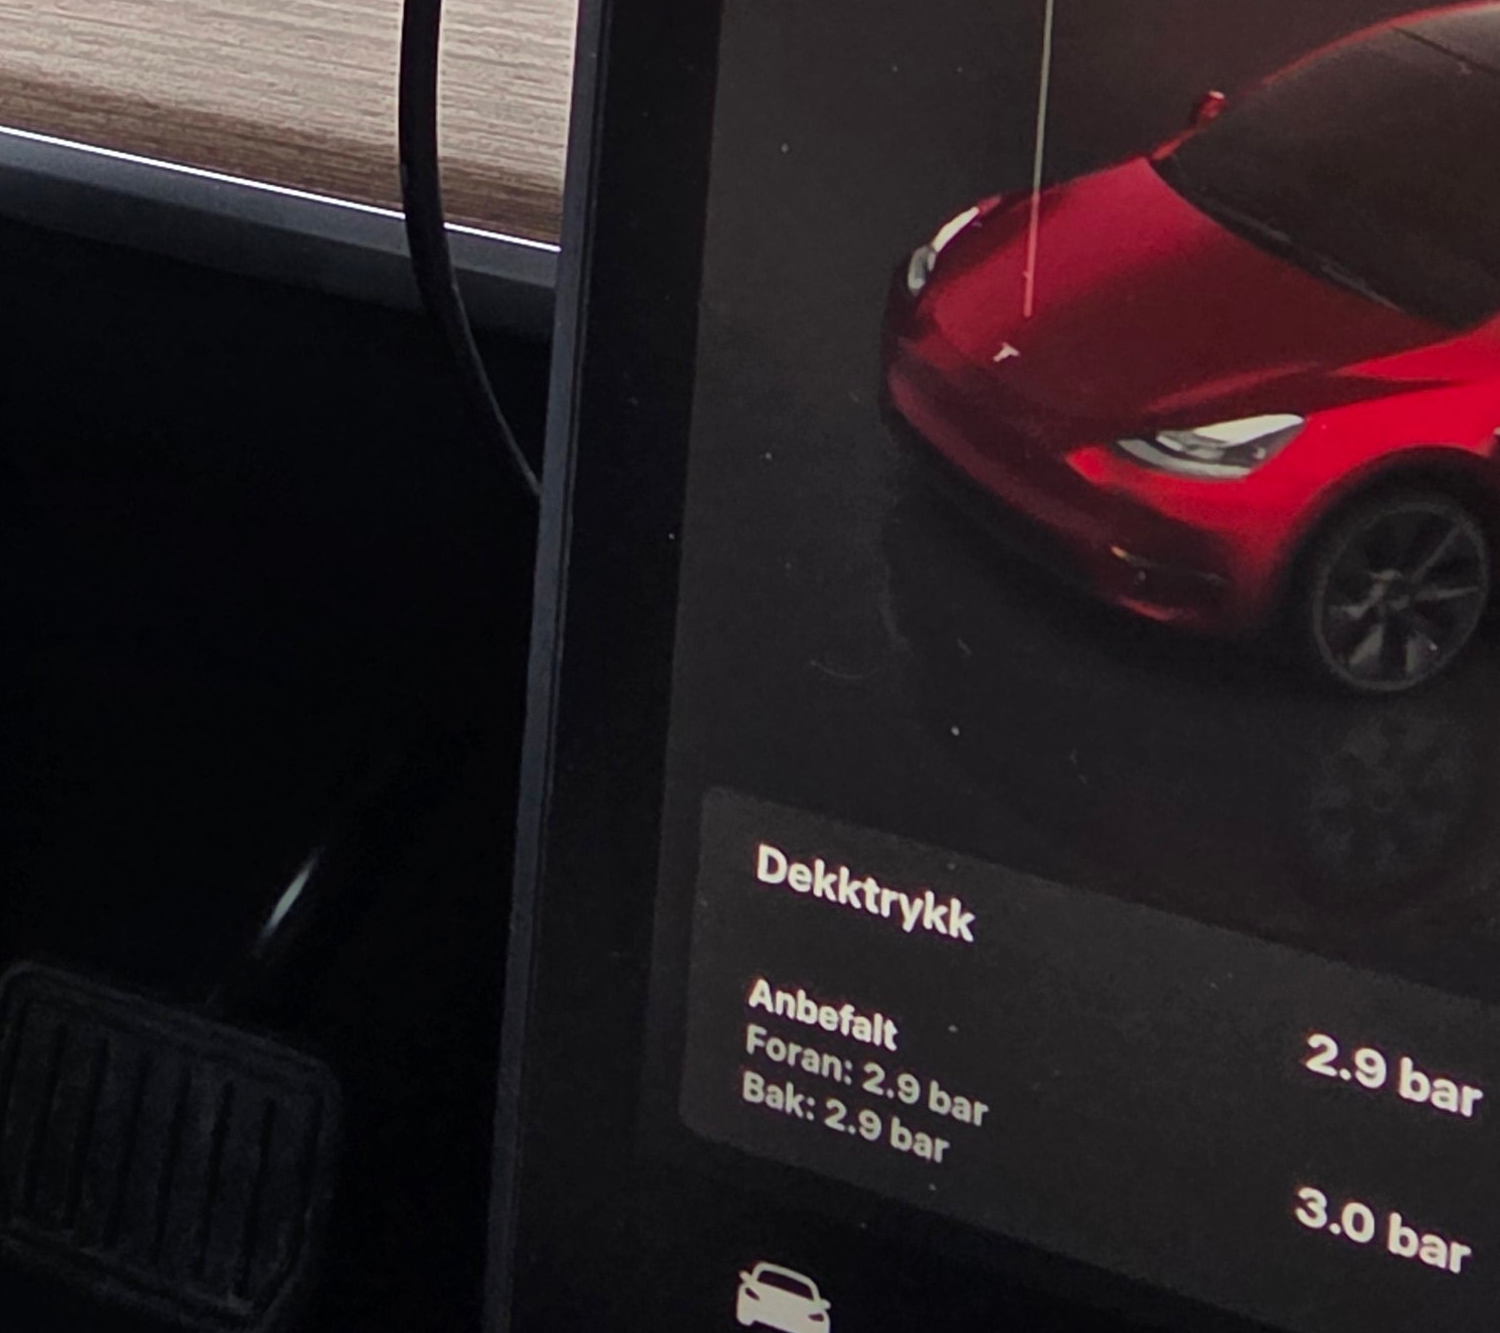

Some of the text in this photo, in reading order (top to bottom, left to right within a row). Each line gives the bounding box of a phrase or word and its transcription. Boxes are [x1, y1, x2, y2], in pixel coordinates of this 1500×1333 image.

[756, 844, 976, 943] Dekktrykk
[748, 979, 898, 1052] Anbefalt
[742, 1071, 950, 1163] Bak: 2.9 bar
[746, 1024, 990, 1126] Foran: 2.9 bar
[1305, 1034, 1484, 1118] 2.9 bar
[1295, 1187, 1473, 1274] 3.0 bar
